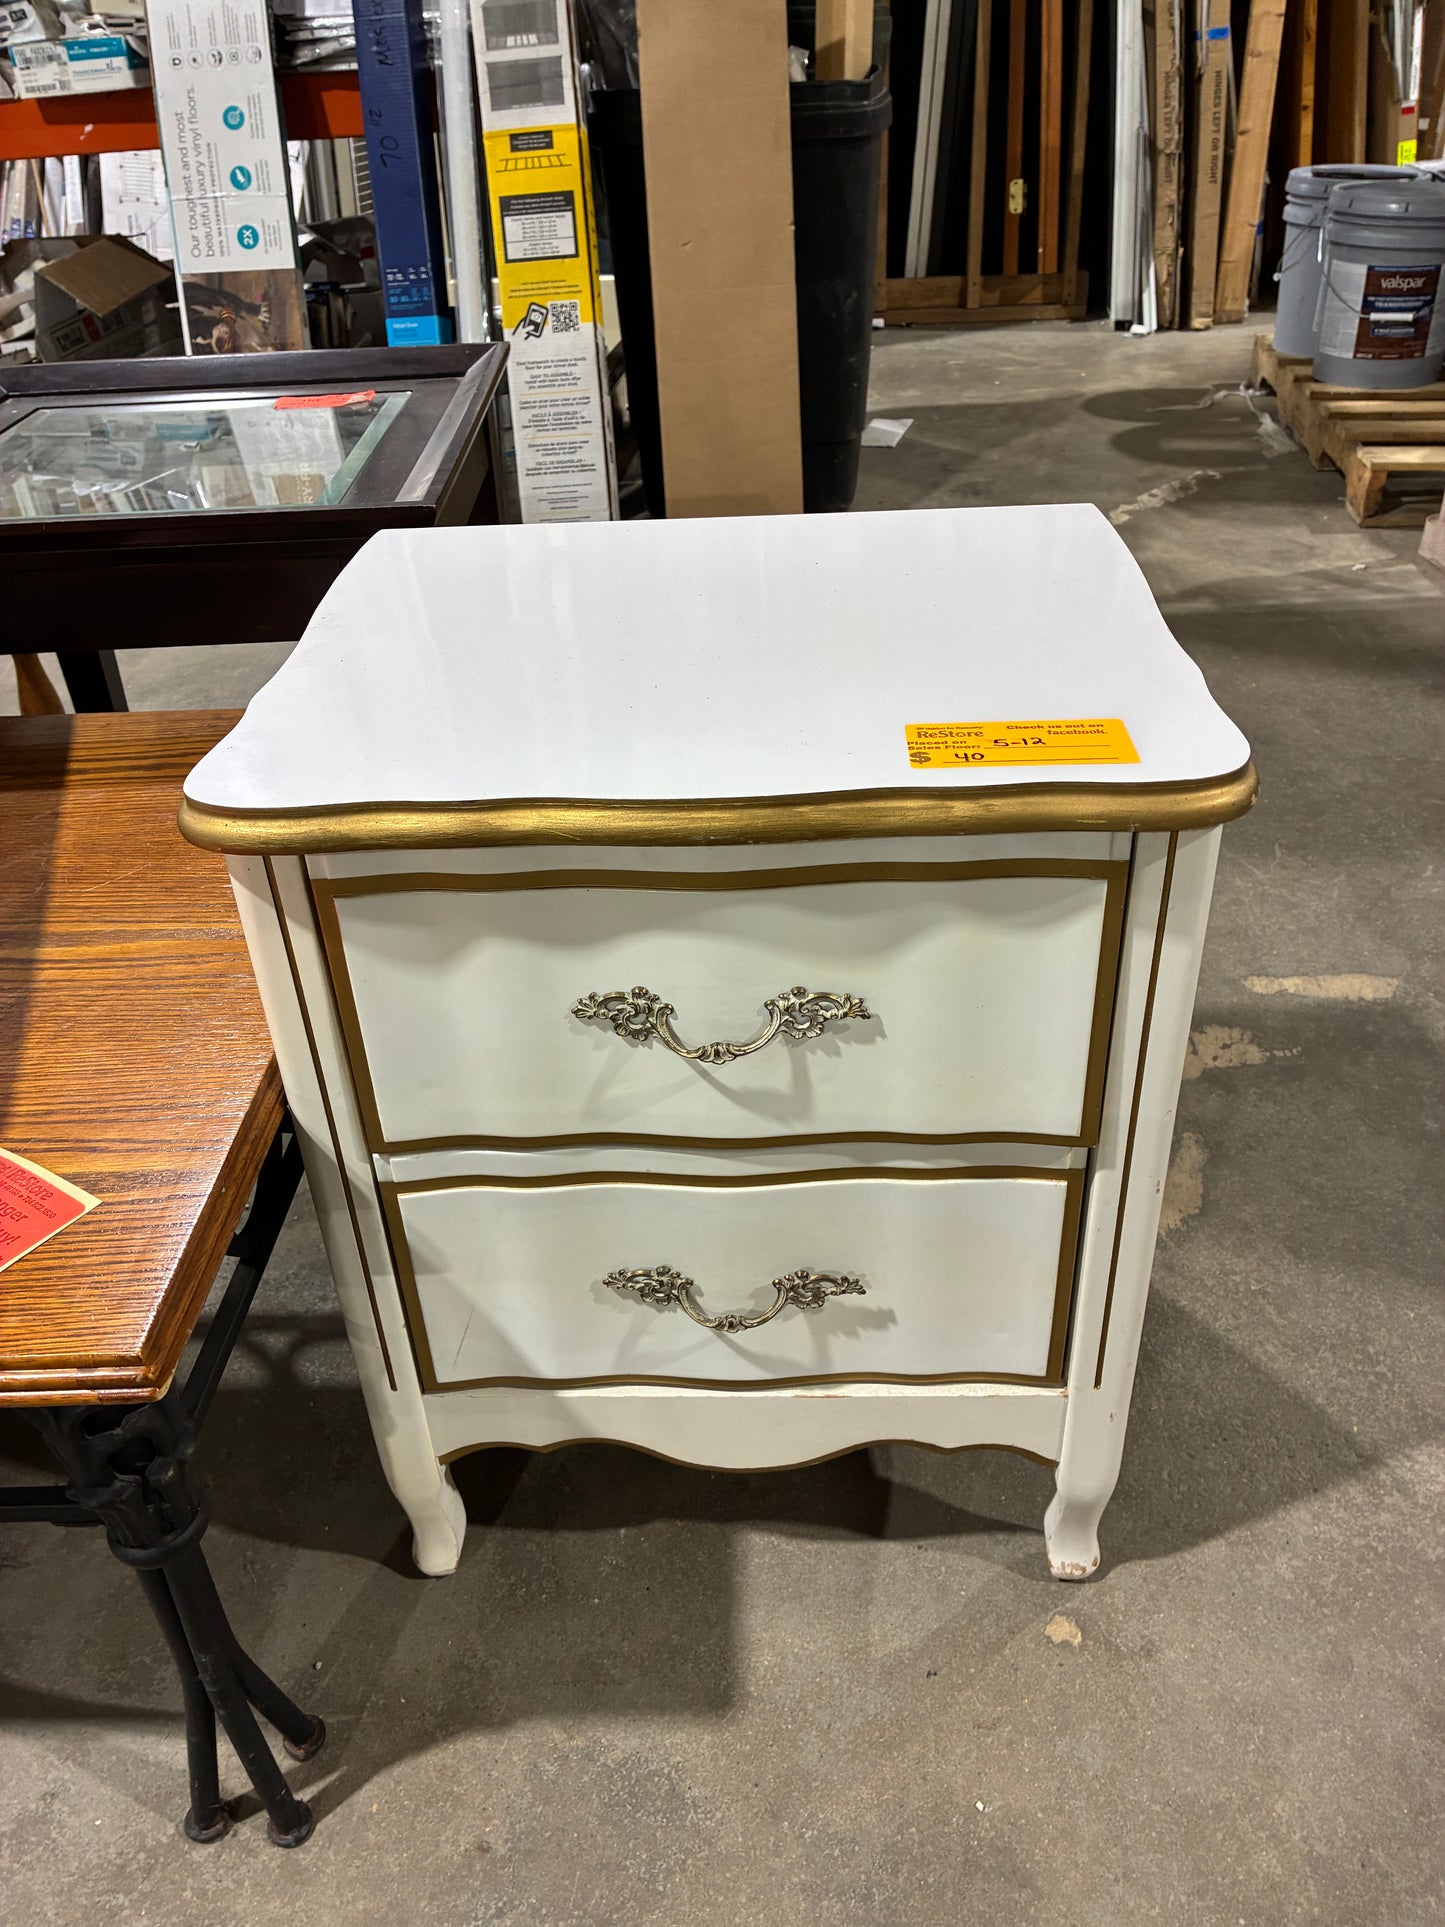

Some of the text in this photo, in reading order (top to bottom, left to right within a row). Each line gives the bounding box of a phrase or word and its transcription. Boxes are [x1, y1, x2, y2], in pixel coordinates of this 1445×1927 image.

[1209, 70, 1222, 184] HINGES LEFT OR RIGHT
[186, 85, 215, 258] beautiful luxury vinyl floors.
[174, 111, 202, 258] Our toughest and most
[242, 228, 253, 246] 2X
[1380, 275, 1427, 291] valspar
[917, 730, 984, 739] ReStore
[909, 751, 931, 764] $
[954, 752, 985, 762] 40
[6, 1169, 54, 1200] ReStore
[0, 1202, 29, 1222] nger
